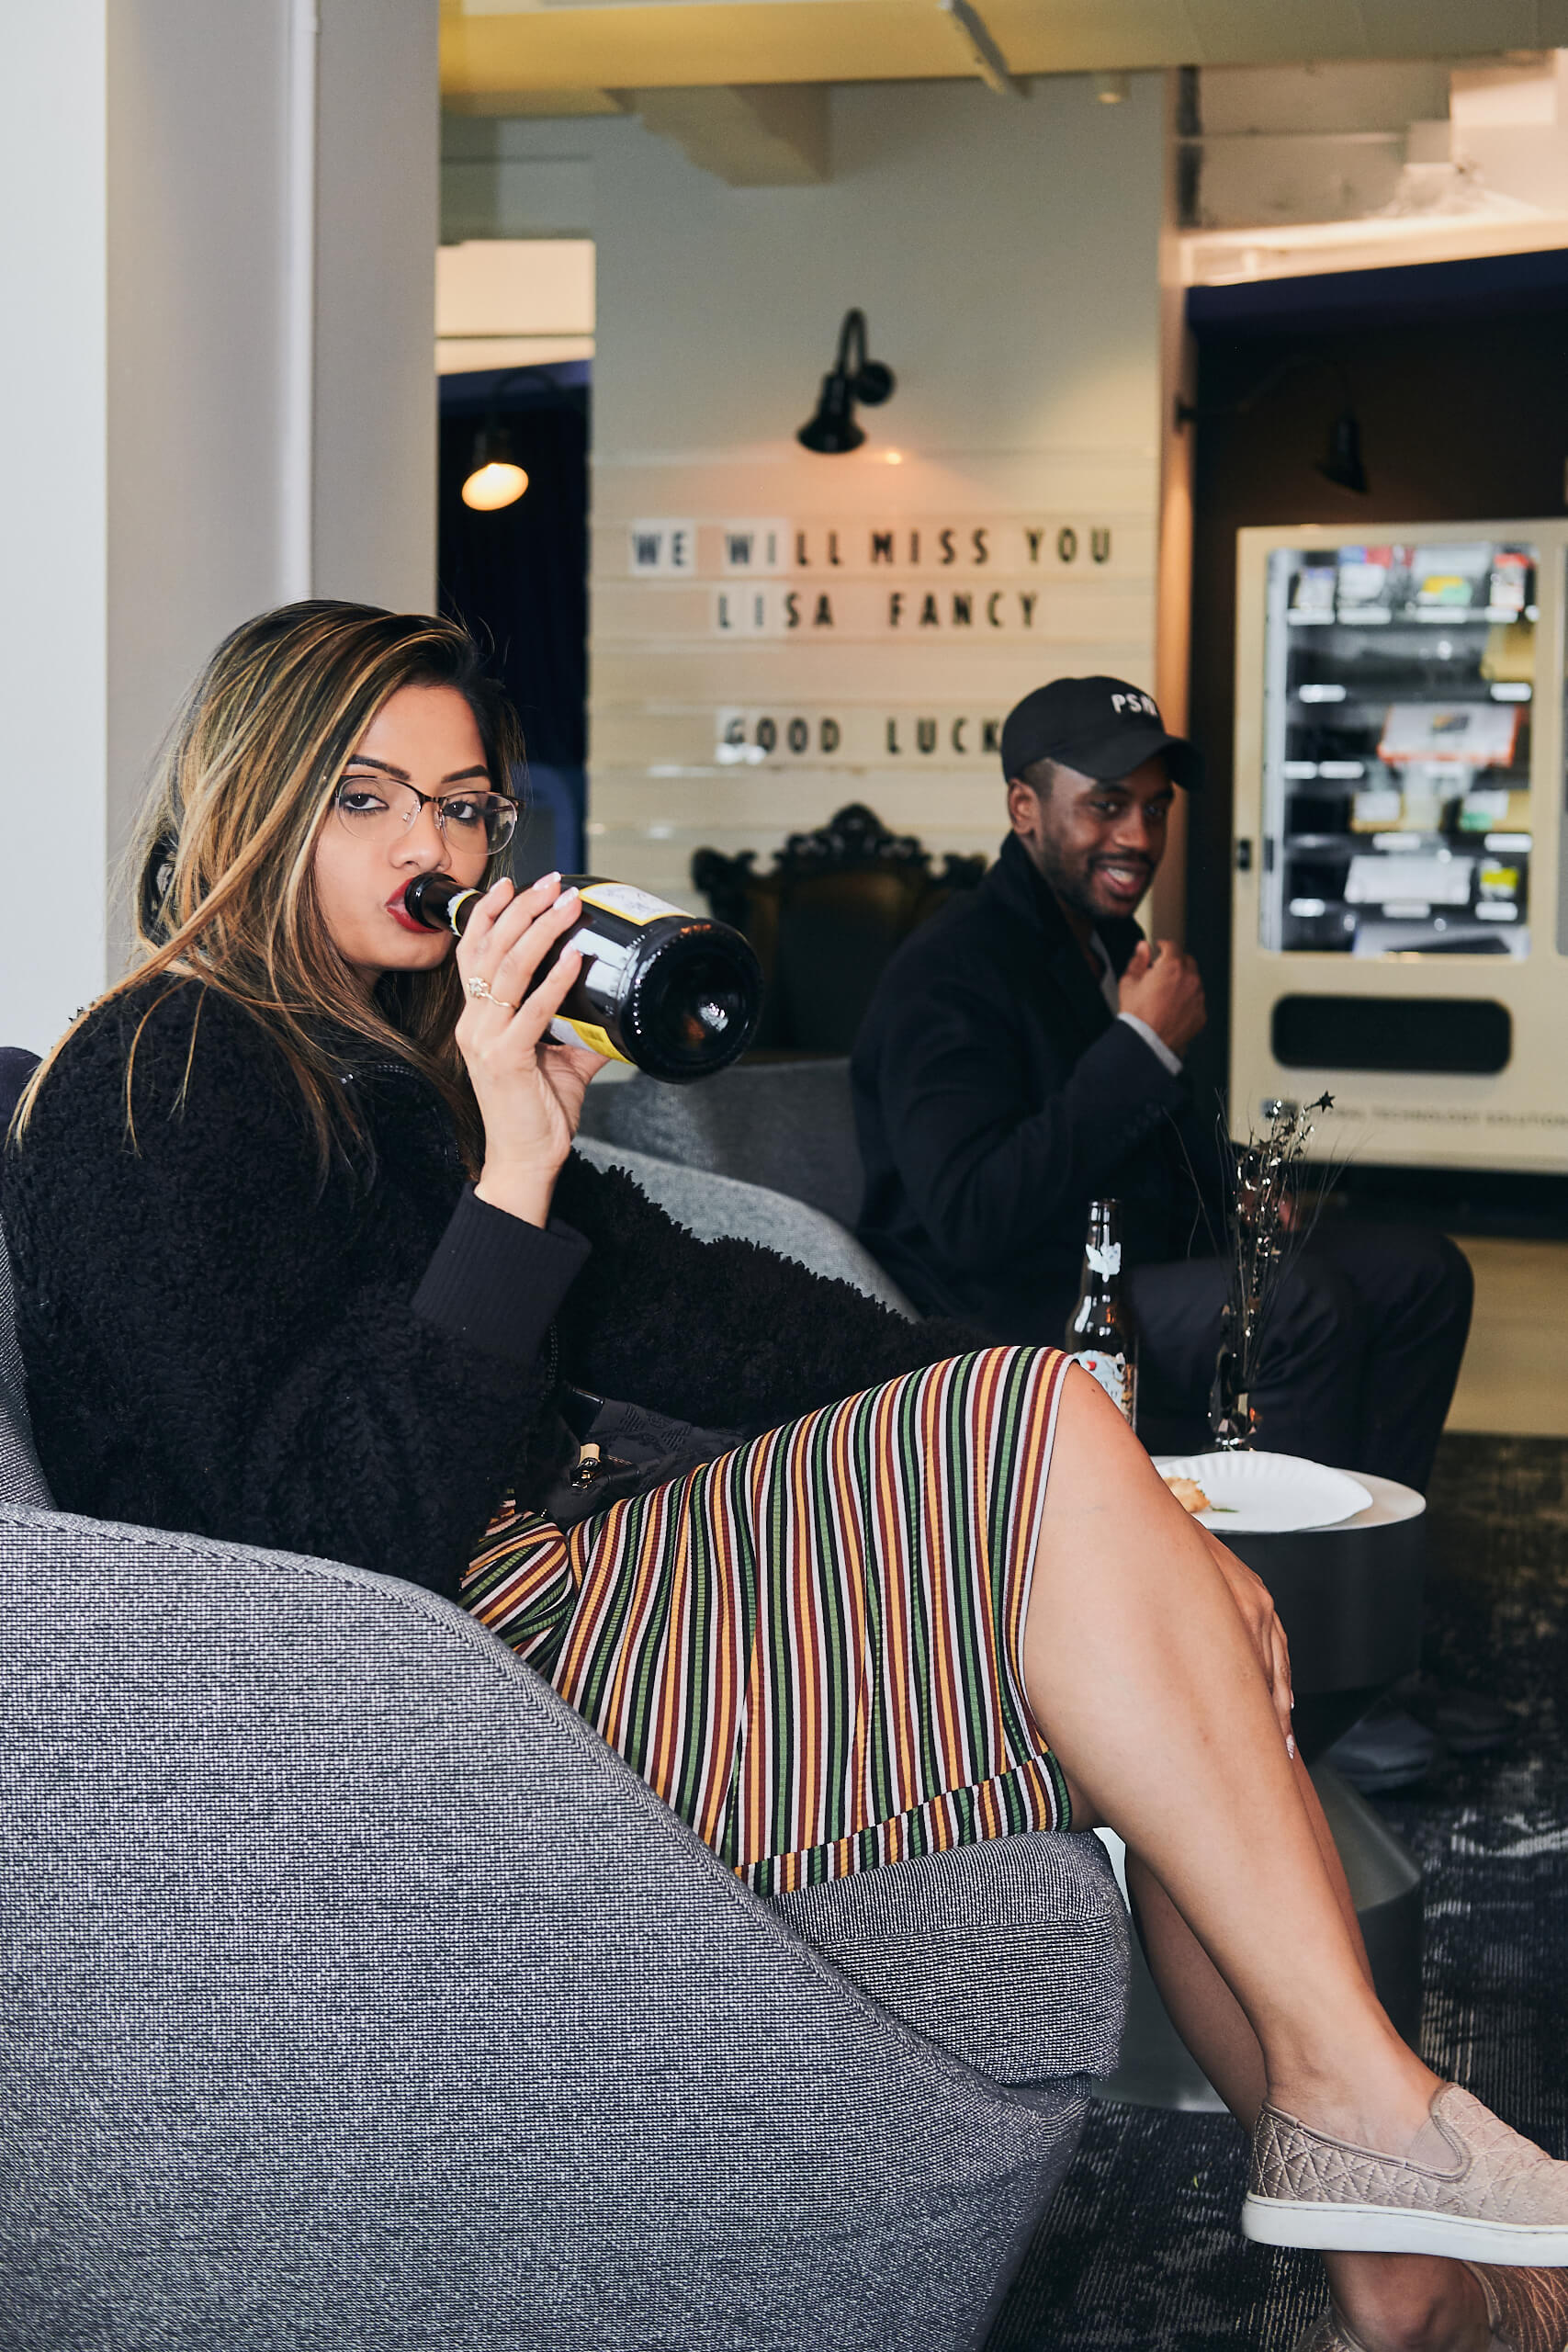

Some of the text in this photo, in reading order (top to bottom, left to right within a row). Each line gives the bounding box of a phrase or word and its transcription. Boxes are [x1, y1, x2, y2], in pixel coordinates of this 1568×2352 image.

[632, 526, 1111, 567] WE WILL MISS YOU
[718, 591, 1038, 628] LISA FANCY
[724, 717, 1001, 755] GOOD LUCK
